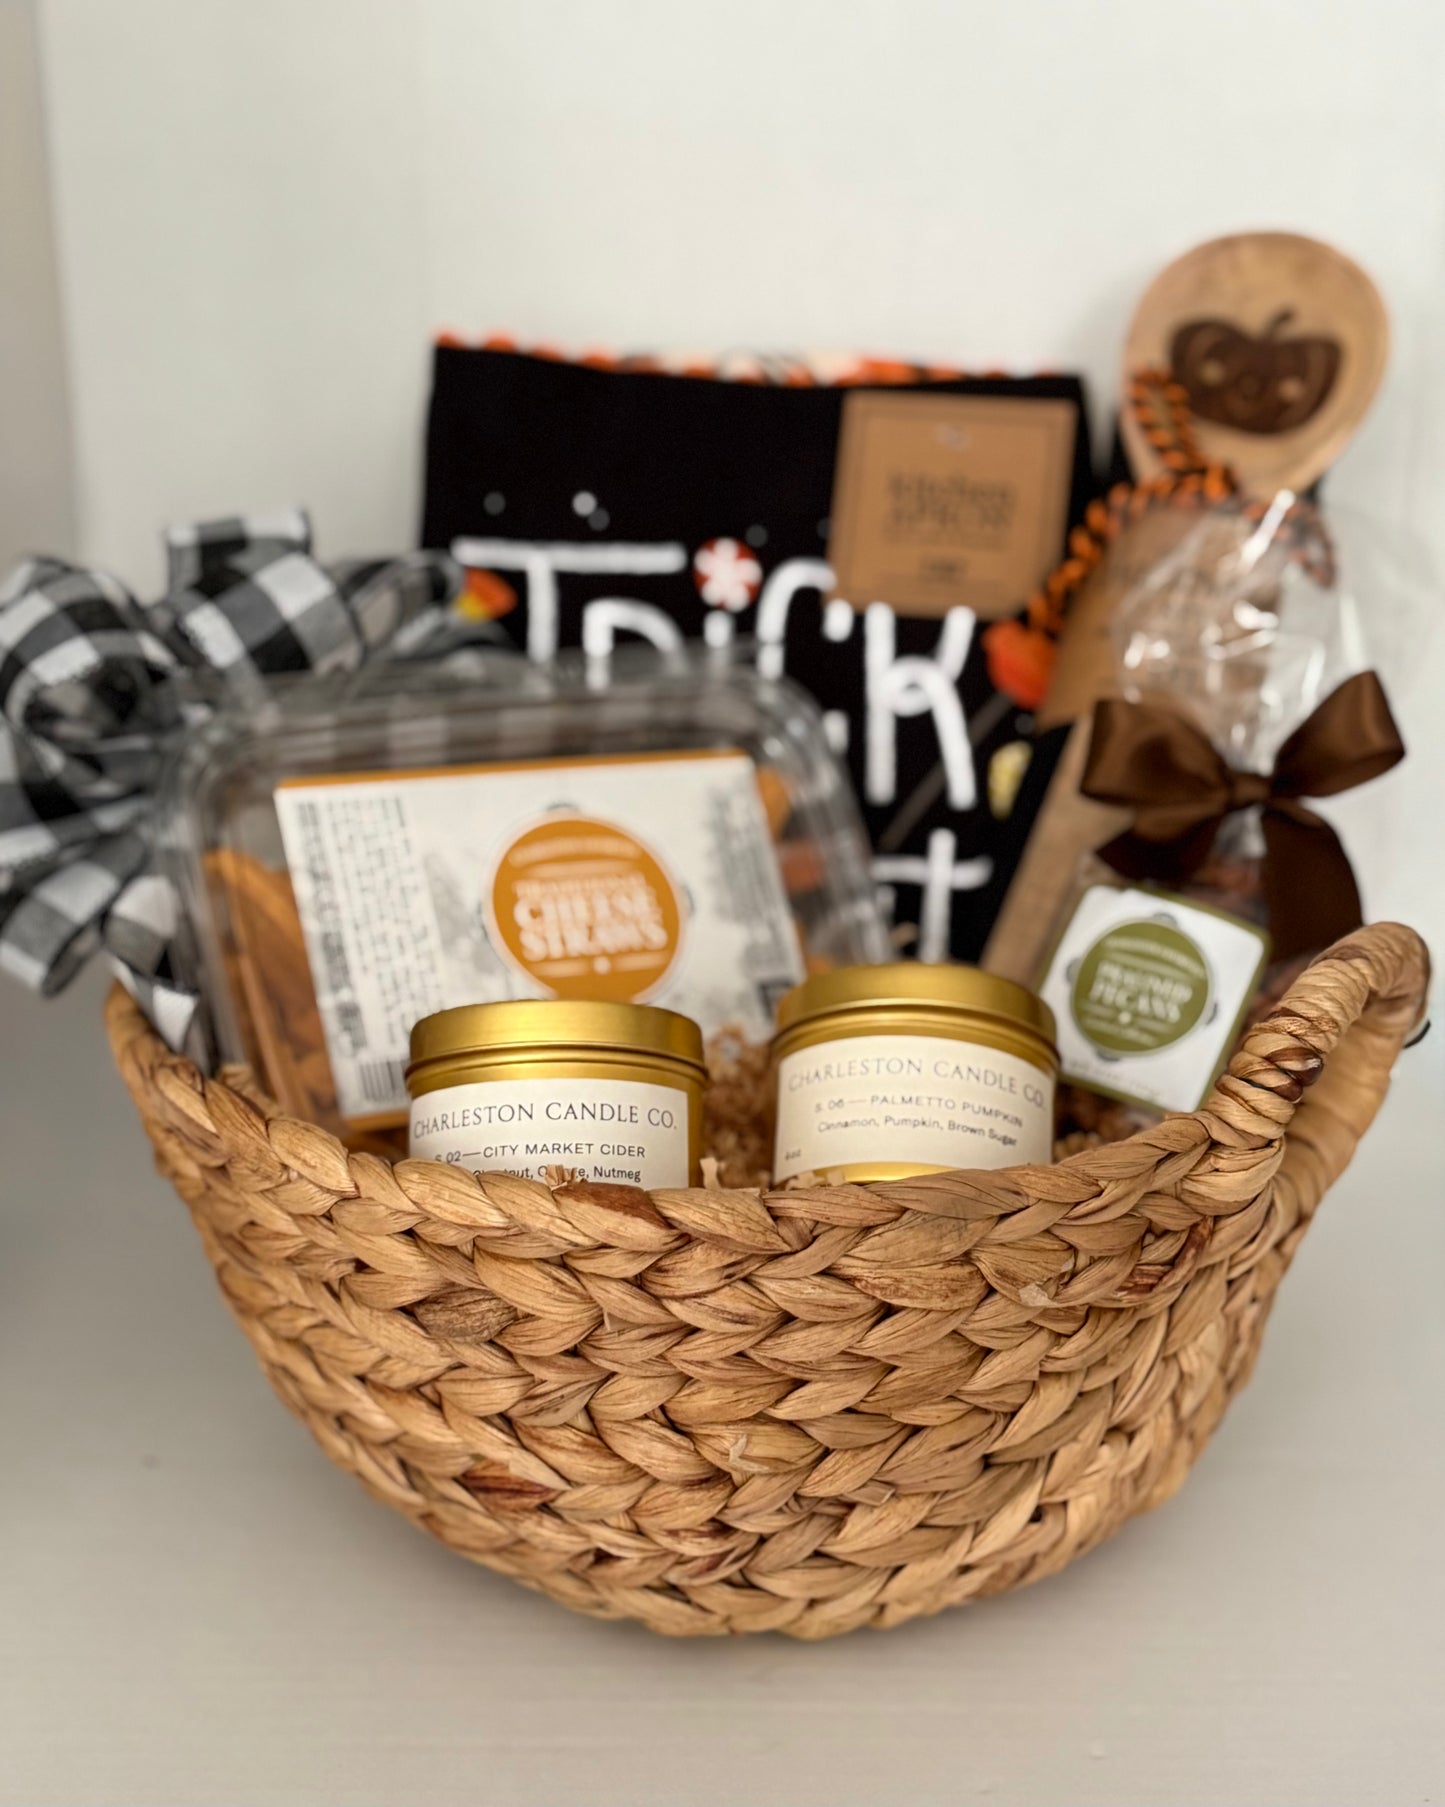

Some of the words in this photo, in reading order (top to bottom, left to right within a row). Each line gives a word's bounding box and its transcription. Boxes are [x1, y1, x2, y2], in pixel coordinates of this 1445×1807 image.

[789, 1057, 922, 1092] CHARLESTON
[934, 1060, 1017, 1094] CANDLE
[1023, 1083, 1047, 1111] CO.
[414, 1103, 534, 1139] CHARLESTON
[545, 1102, 639, 1124] CANDLE
[648, 1107, 677, 1130] CO.
[818, 1117, 880, 1133] Cinnamon,
[885, 1114, 944, 1132] Pumpkin,
[948, 1119, 985, 1136] Brown
[962, 1101, 1023, 1128] PUMPKIN
[525, 1143, 594, 1155] MARKET
[600, 1144, 645, 1158] CIDER
[593, 1166, 641, 1183] Nutmeg
